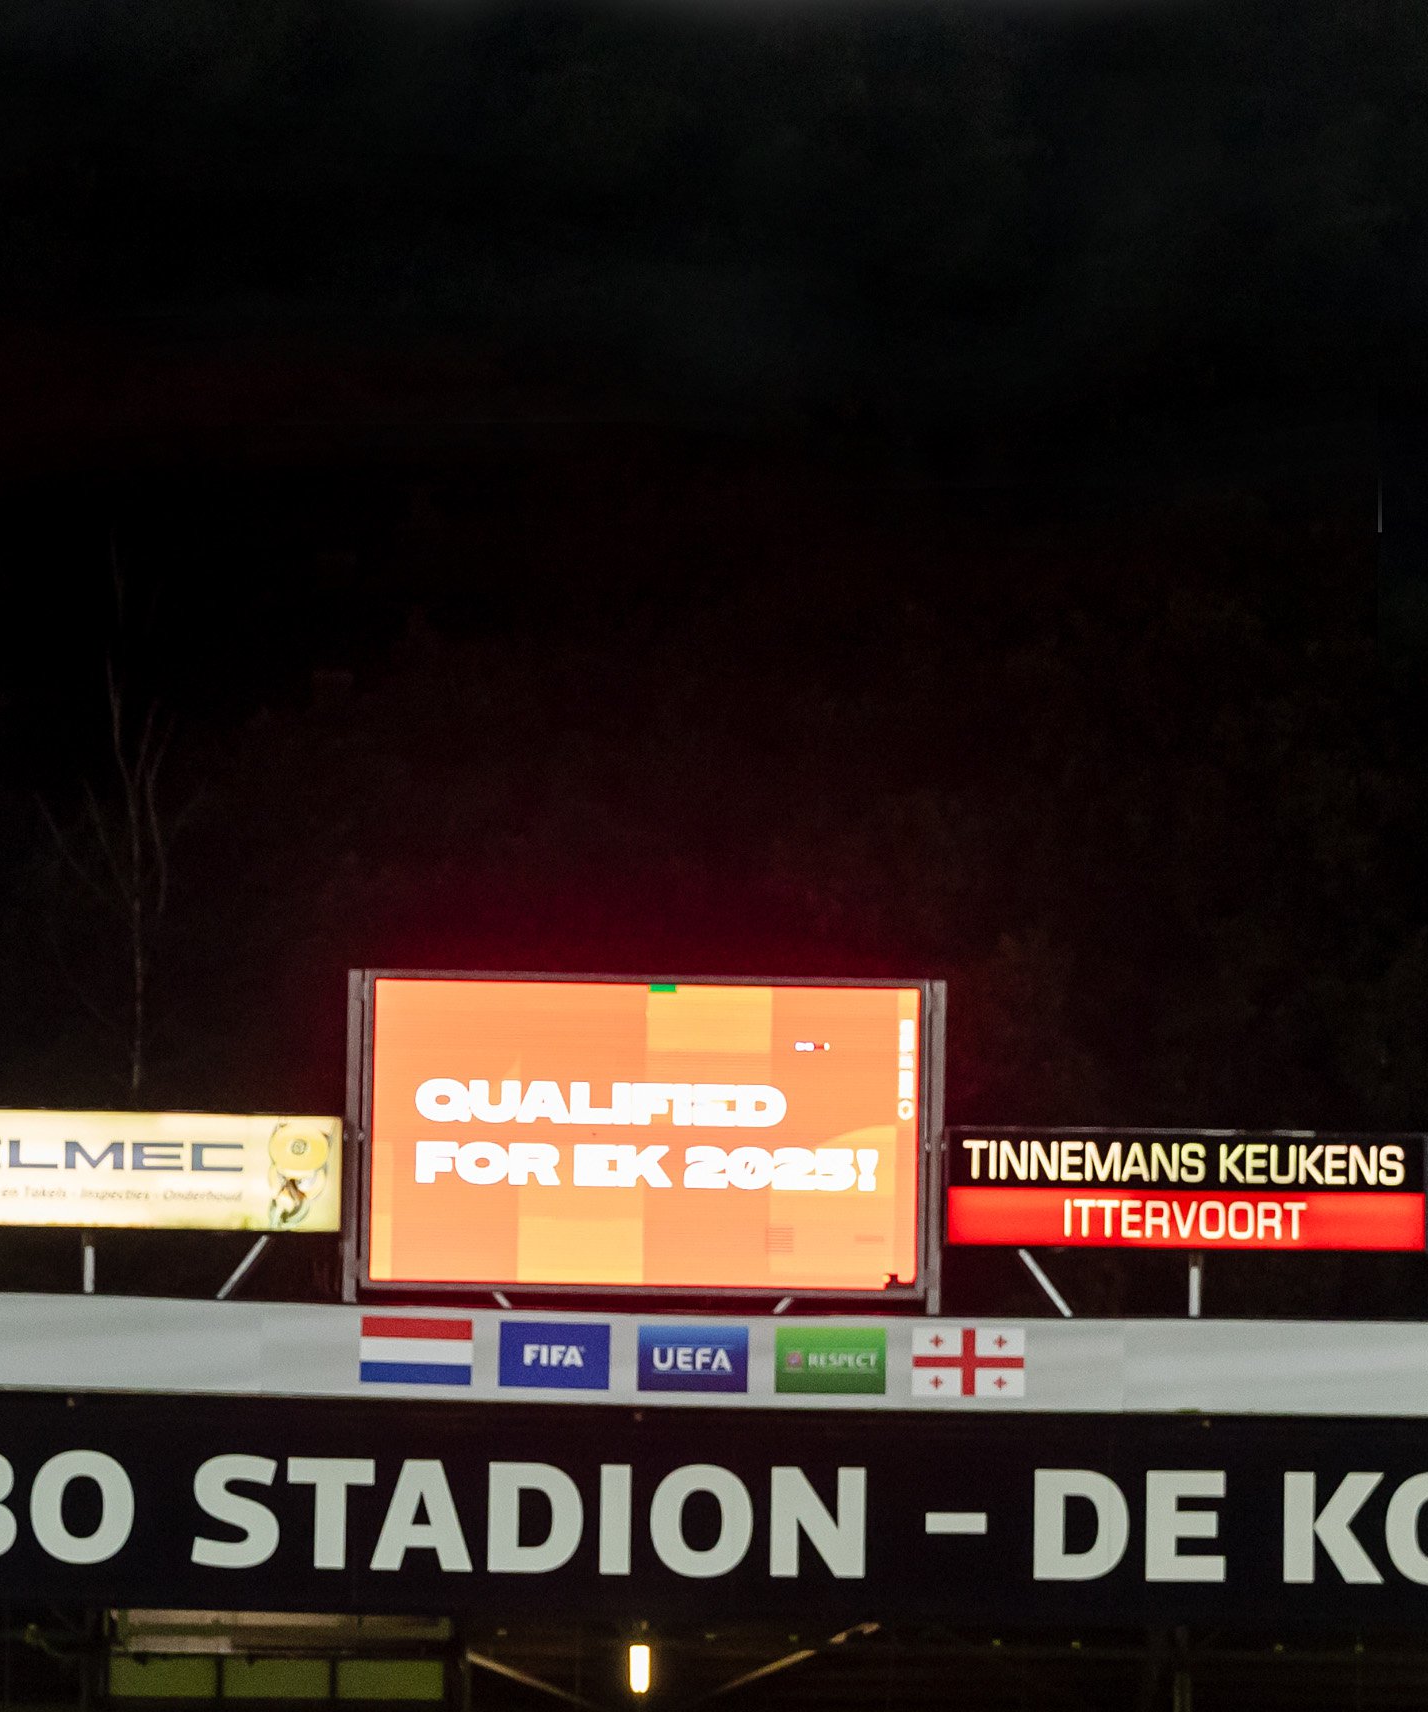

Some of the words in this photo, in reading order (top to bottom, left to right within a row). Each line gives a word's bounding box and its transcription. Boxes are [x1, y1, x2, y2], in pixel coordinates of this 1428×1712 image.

[415, 1078, 787, 1127] QUALIFIED
[415, 1140, 561, 1185] FOR
[573, 1143, 673, 1188] EK
[683, 1146, 879, 1192] 2025!
[962, 1139, 1209, 1184] TINNEMANS
[1217, 1143, 1406, 1186] KEUKENS
[1062, 1198, 1307, 1242] ITTERVOORT
[523, 1343, 584, 1368] FIFA
[652, 1346, 733, 1372] UEFA
[808, 1351, 878, 1368] RESPECT
[190, 1453, 867, 1579] STADION
[1033, 1468, 1227, 1582] DE
